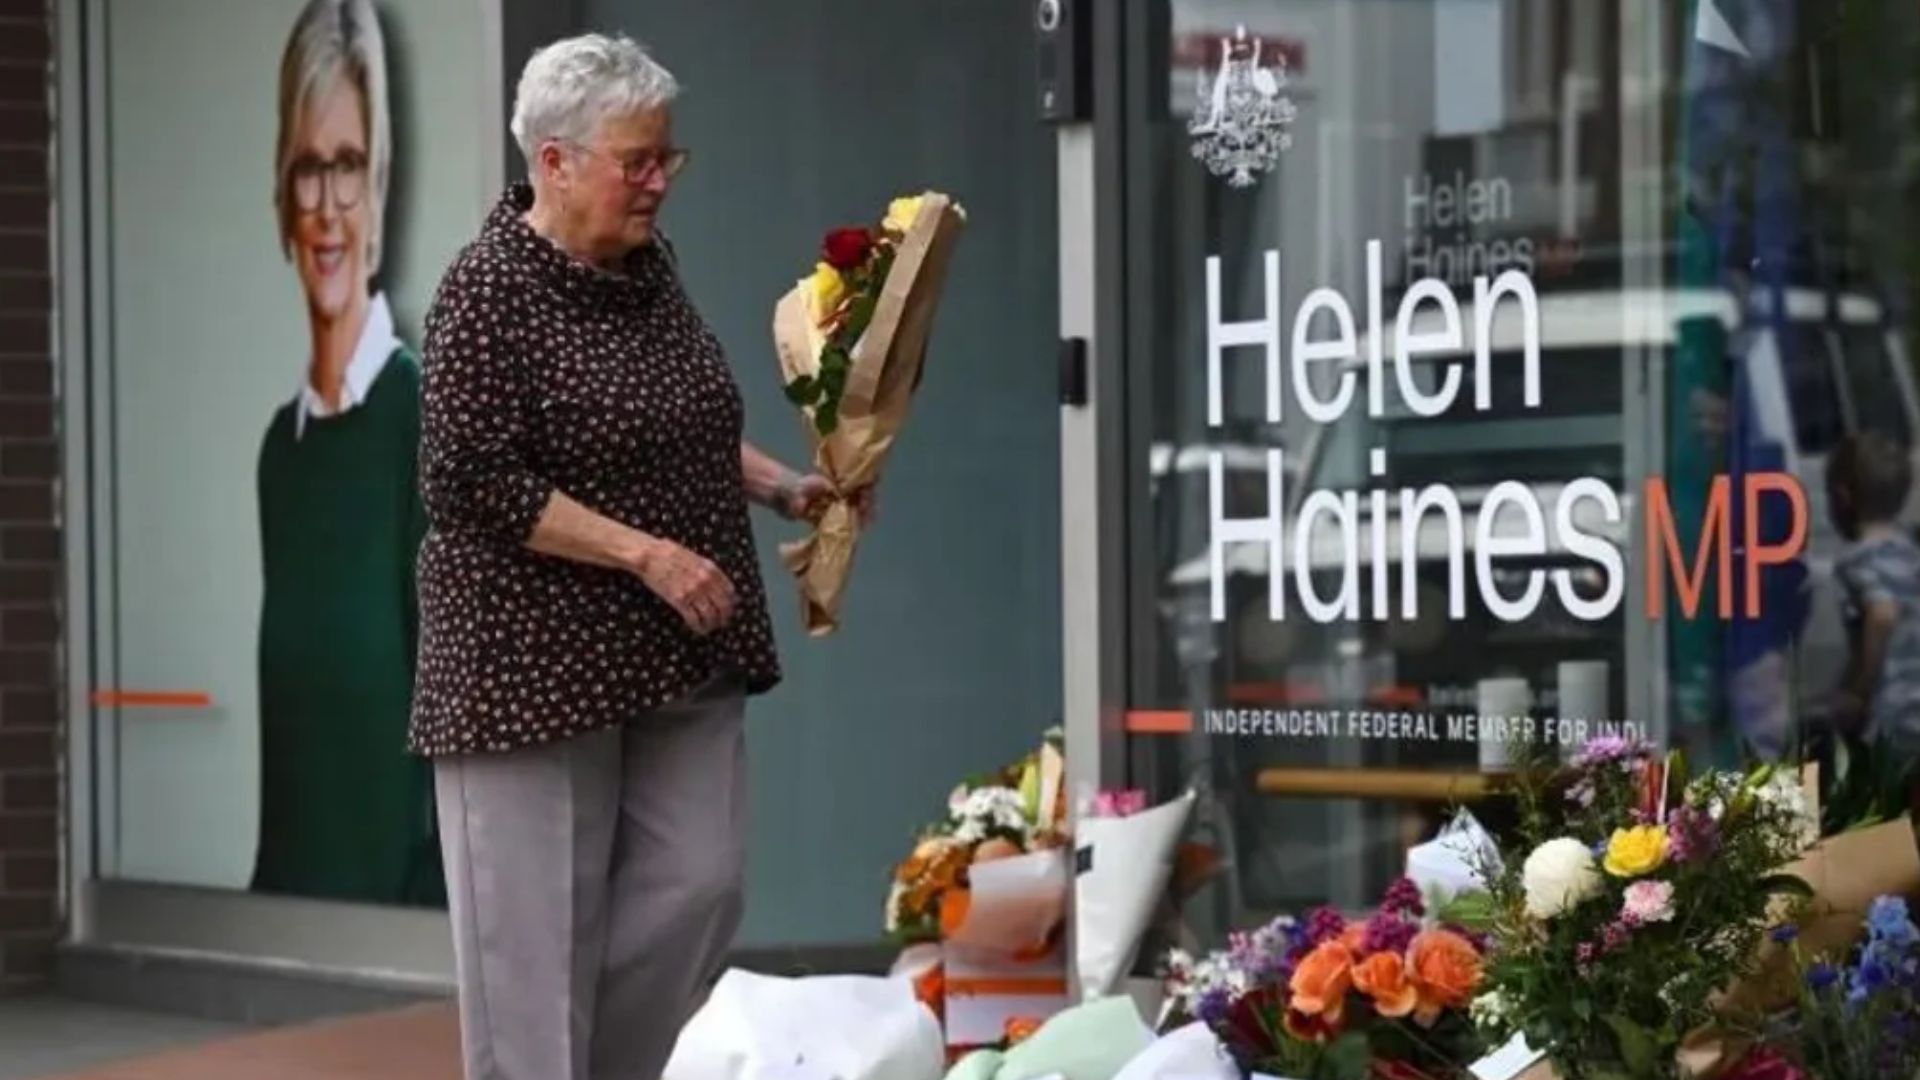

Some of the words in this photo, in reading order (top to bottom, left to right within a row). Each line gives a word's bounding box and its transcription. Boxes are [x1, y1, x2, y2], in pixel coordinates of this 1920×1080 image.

[1404, 170, 1512, 229] Helen
[1206, 239, 1541, 425] Helen
[1208, 448, 1624, 622] Haines
[1645, 472, 1809, 621] MP
[1204, 708, 1340, 737] INDEPENDENT
[1348, 711, 1439, 740] FEDERAL
[1447, 714, 1535, 743] MEMBER
[1544, 719, 1588, 745] FOR
